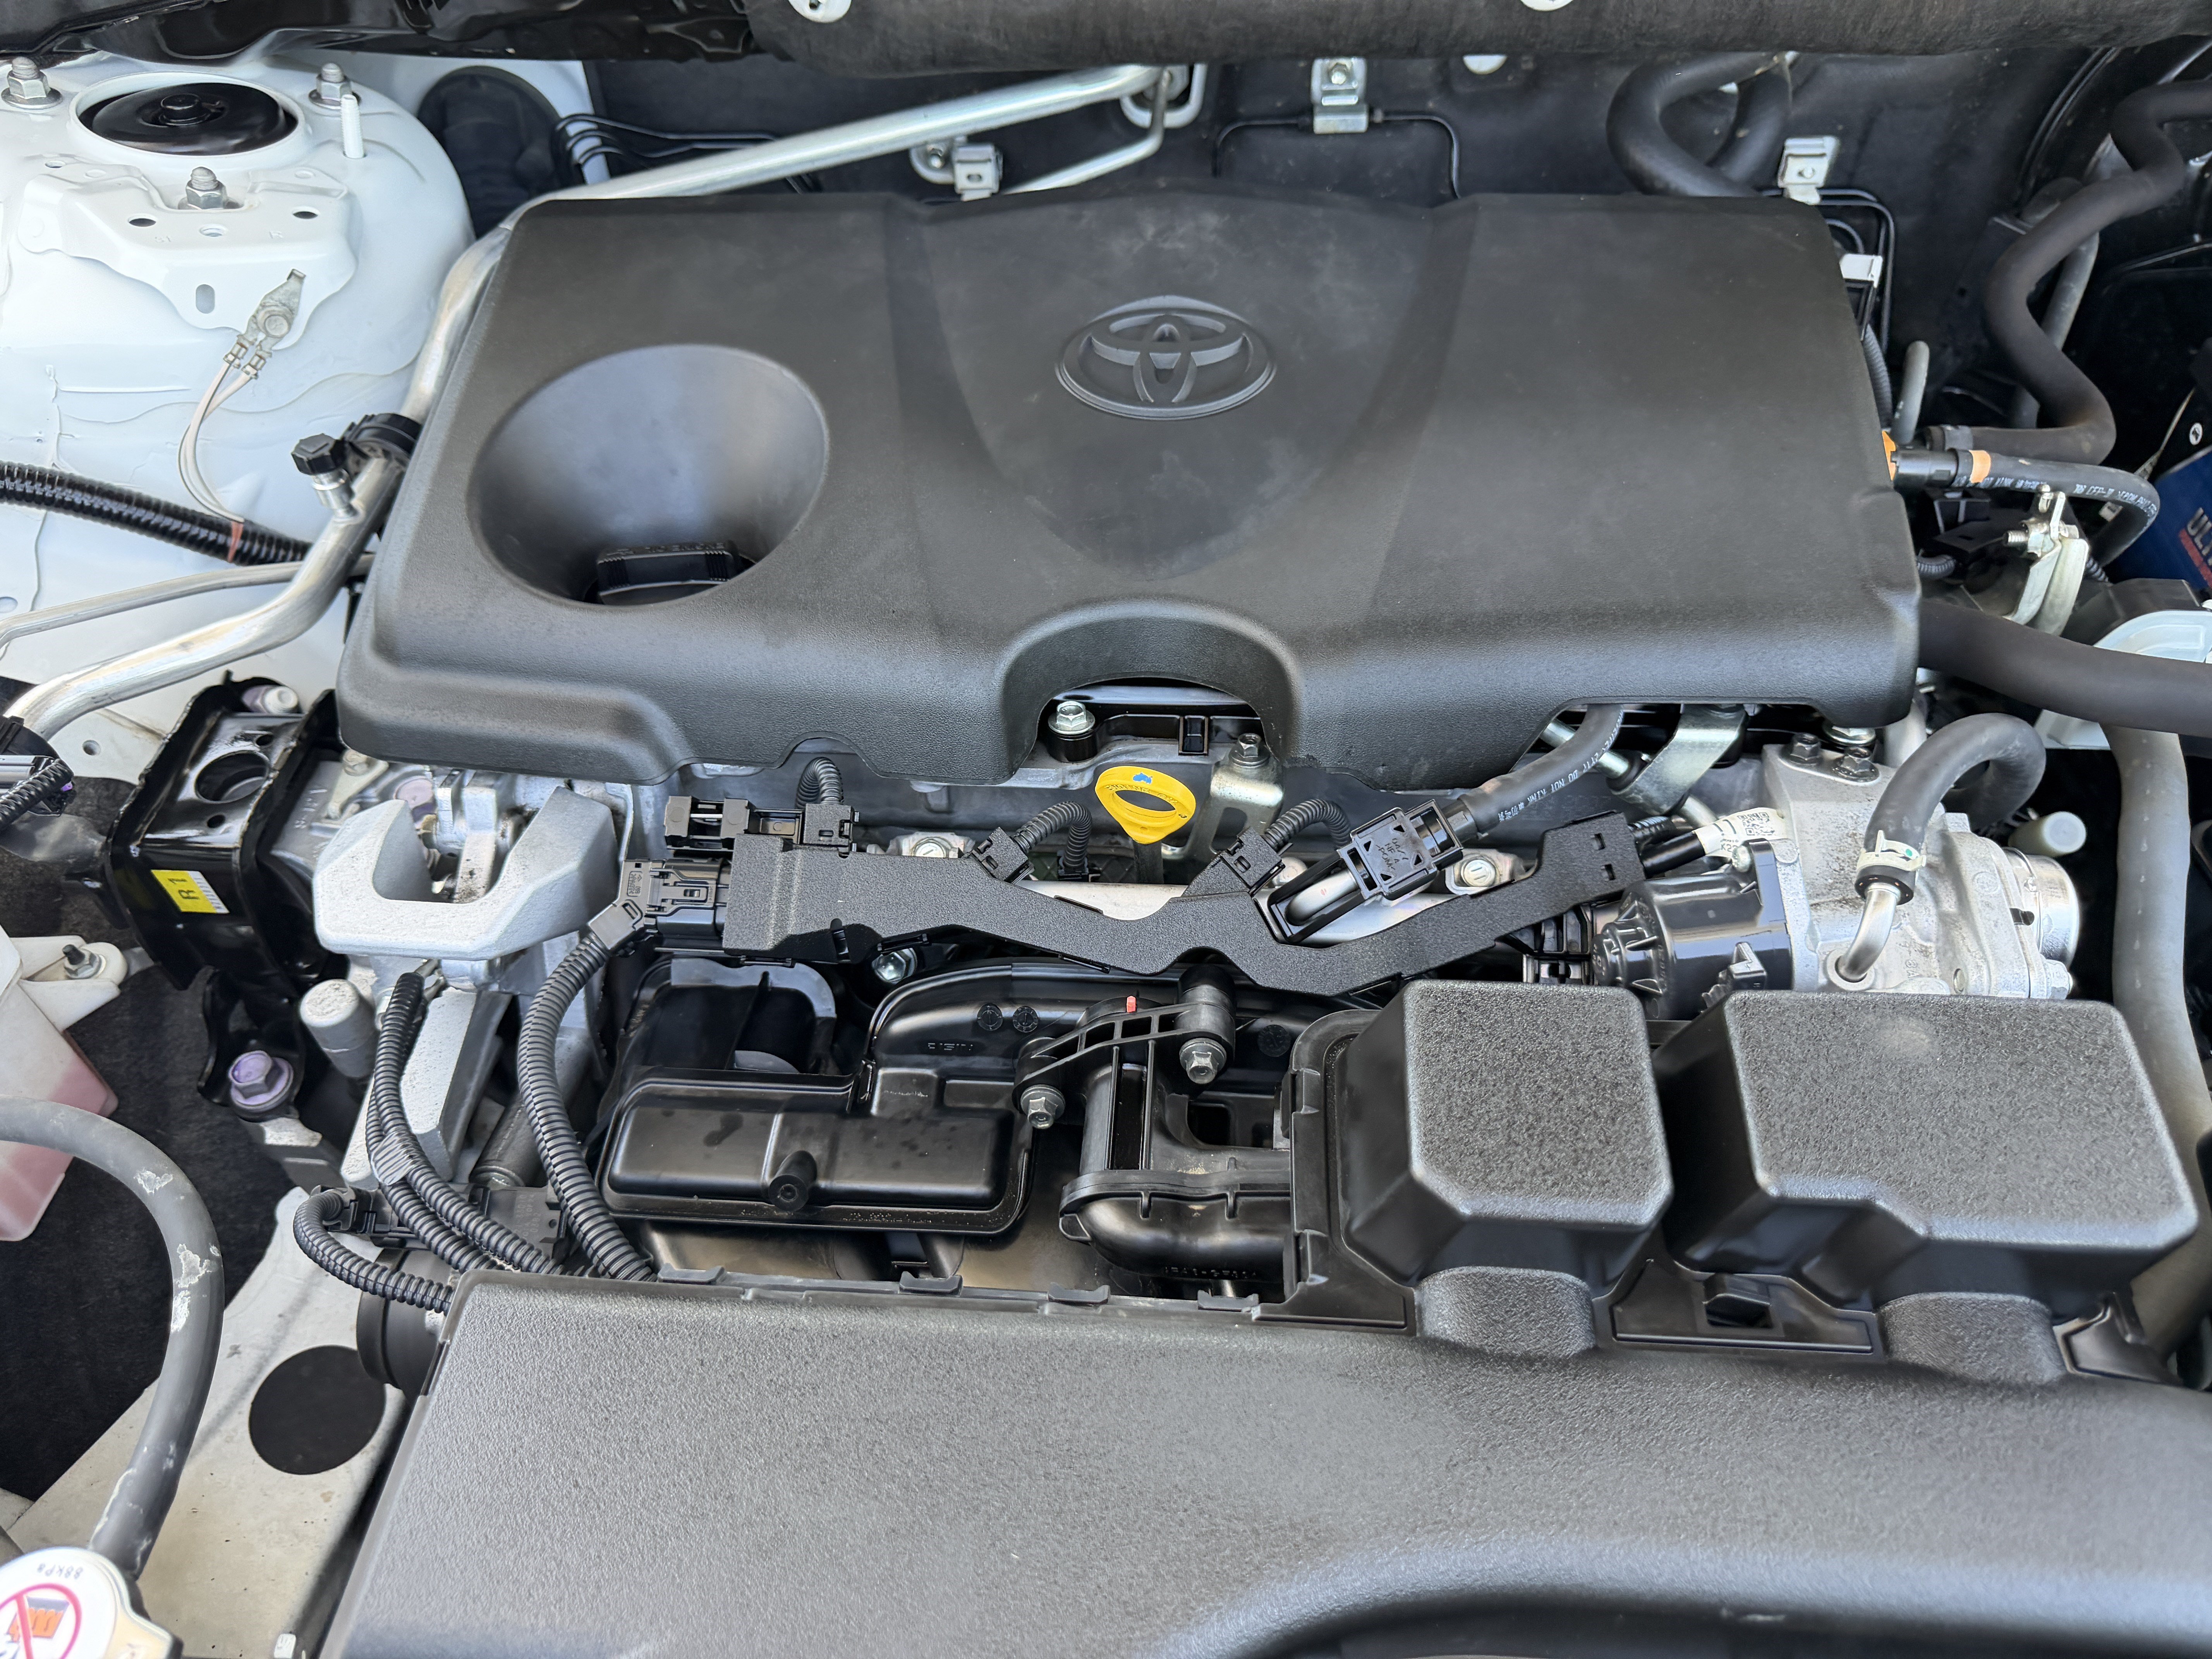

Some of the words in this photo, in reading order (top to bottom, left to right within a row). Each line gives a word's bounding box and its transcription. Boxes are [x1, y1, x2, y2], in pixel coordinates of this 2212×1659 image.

[2187, 507, 2212, 566] UL
[1568, 769, 1578, 783] DO
[1551, 778, 1565, 793] NOT
